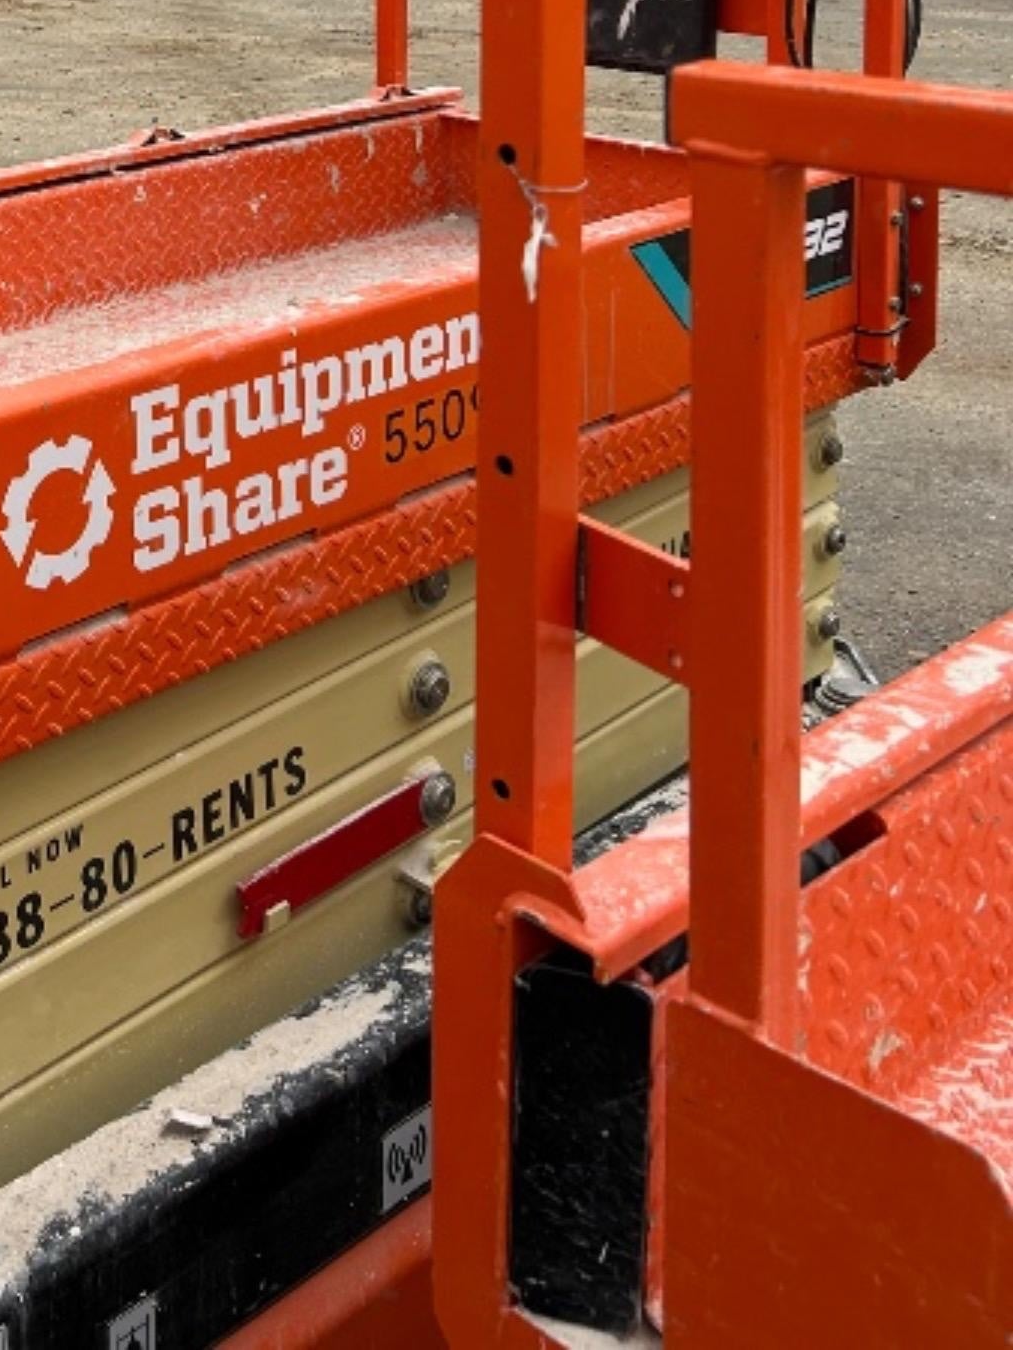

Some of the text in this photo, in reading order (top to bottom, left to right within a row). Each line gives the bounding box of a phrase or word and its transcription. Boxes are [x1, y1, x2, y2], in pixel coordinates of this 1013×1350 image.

[130, 312, 479, 474] Equipmen
[385, 390, 478, 463] 550
[26, 824, 84, 872] NOW
